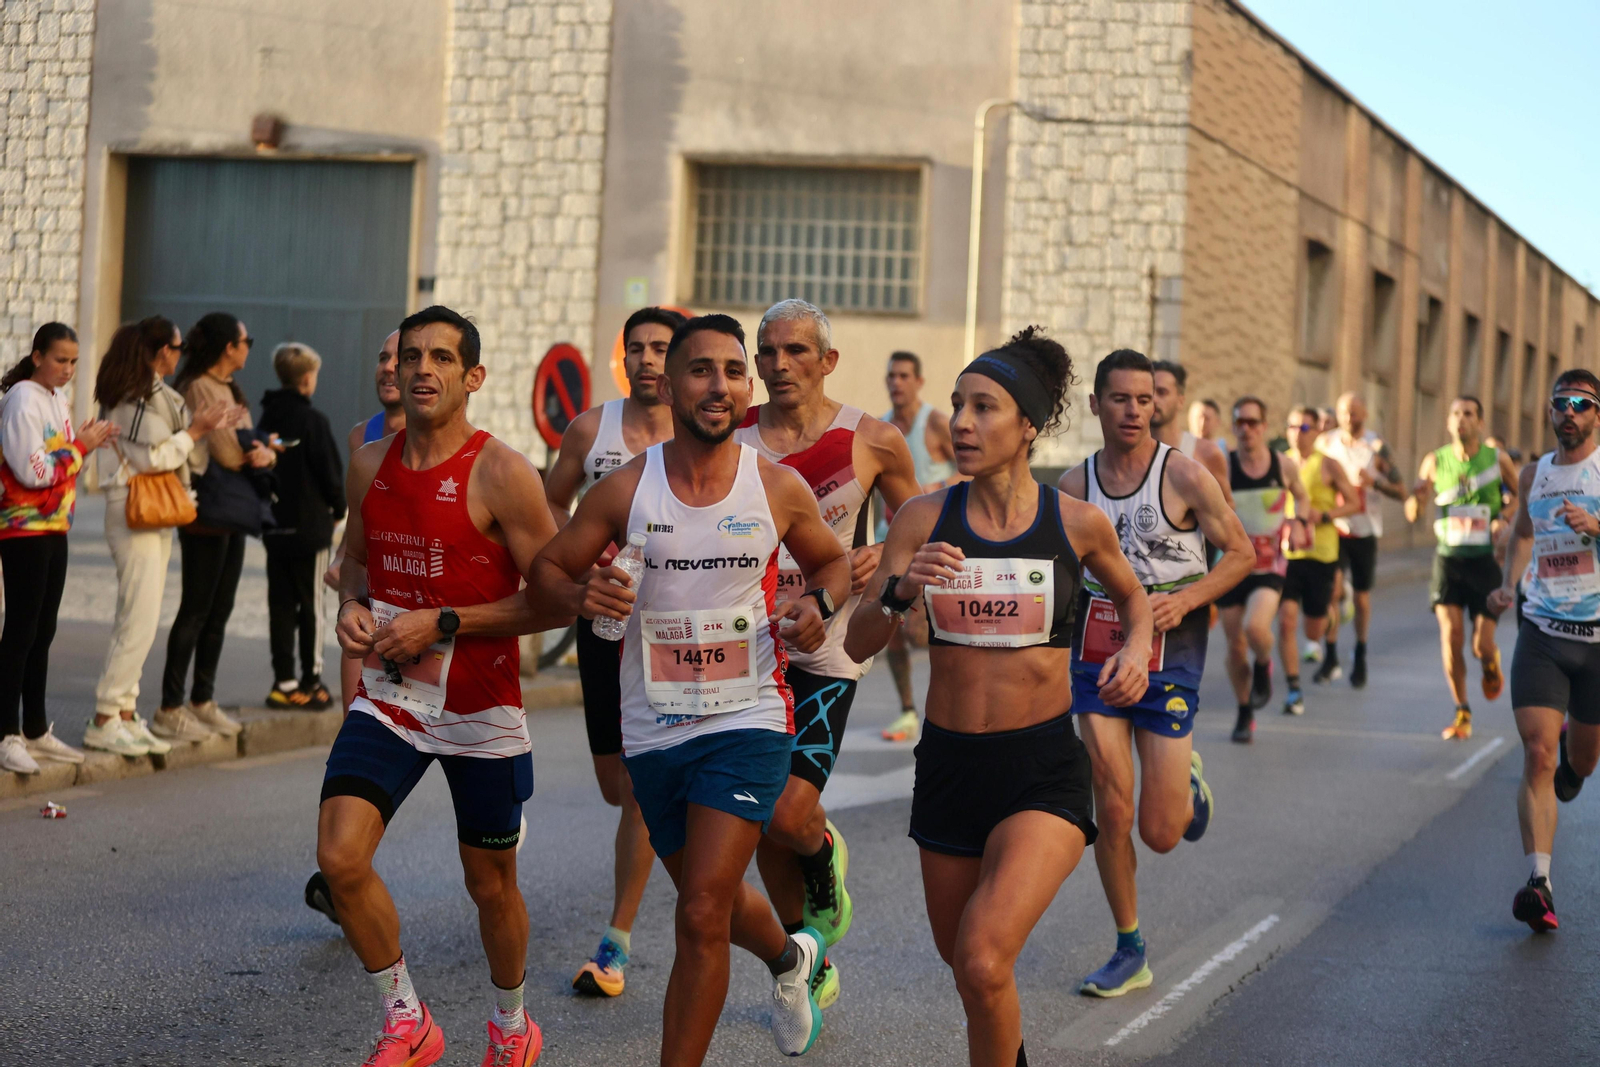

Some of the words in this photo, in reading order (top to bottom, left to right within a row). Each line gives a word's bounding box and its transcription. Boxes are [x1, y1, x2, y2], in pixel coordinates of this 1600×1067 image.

[595, 457, 622, 467] gross
[436, 494, 457, 503] luanvi
[381, 531, 426, 547] GENERALI
[382, 553, 428, 578] MÁLAGA
[1547, 555, 1579, 568] 10258
[996, 573, 1017, 581] 21K
[386, 588, 412, 599] málaga
[957, 600, 1019, 617] 10422
[703, 623, 724, 631] 21K
[655, 630, 685, 640] MÁLAGA
[673, 647, 726, 666] 14476
[691, 687, 720, 696] GENERALI
